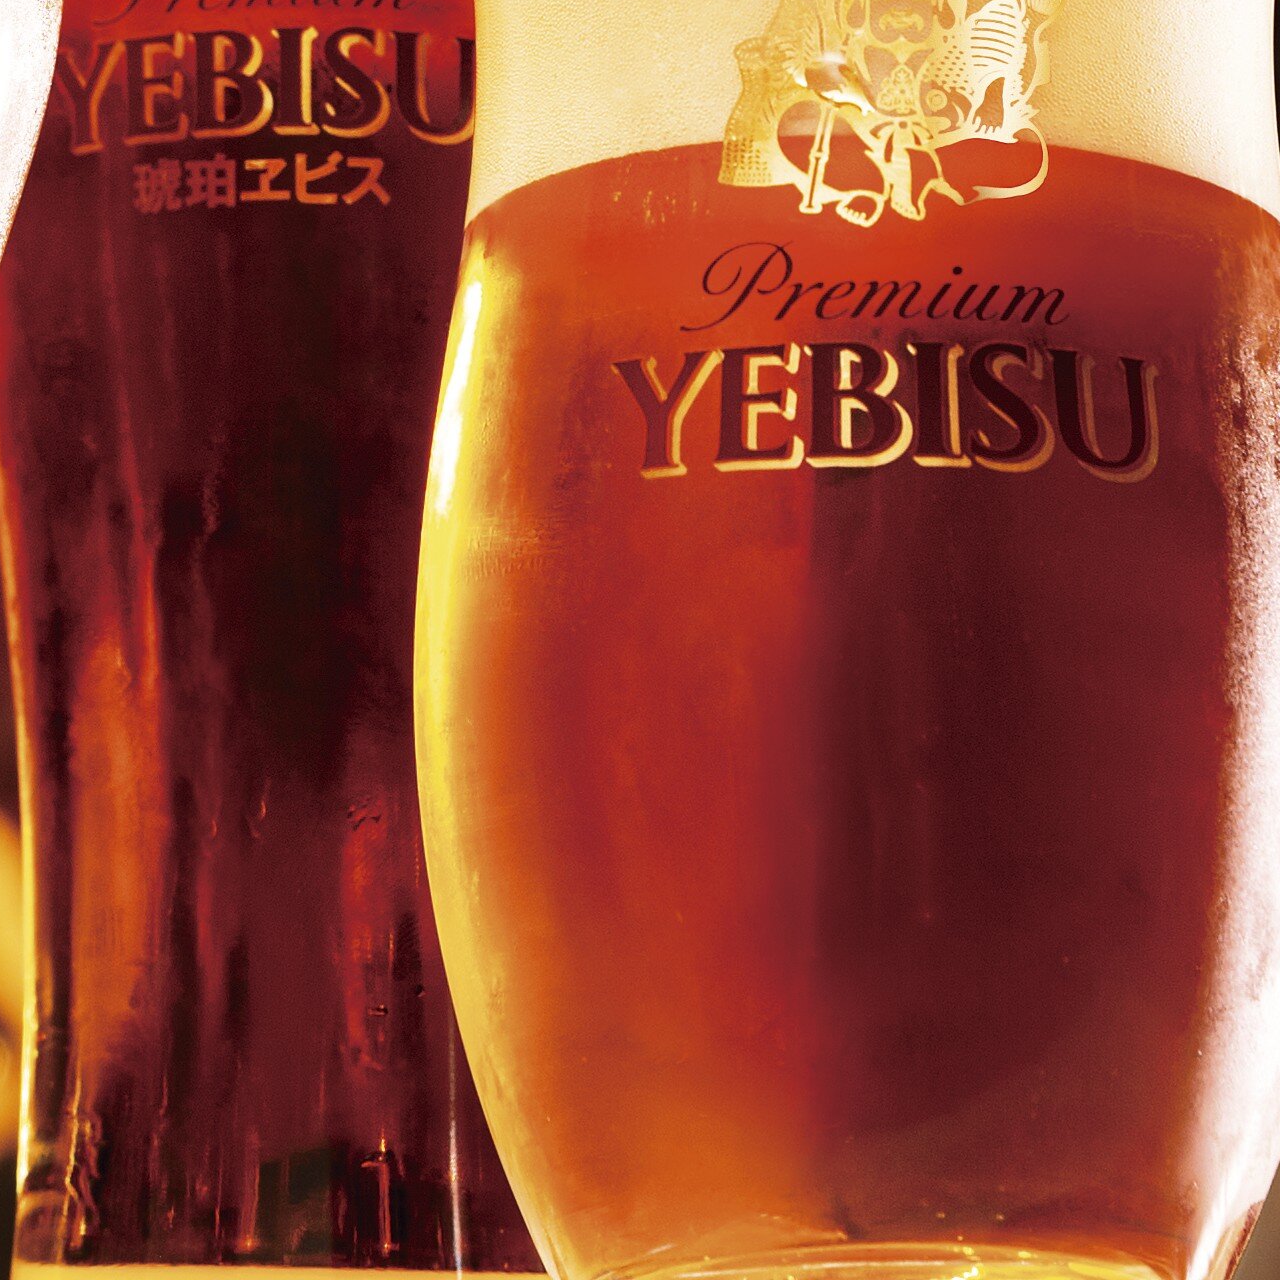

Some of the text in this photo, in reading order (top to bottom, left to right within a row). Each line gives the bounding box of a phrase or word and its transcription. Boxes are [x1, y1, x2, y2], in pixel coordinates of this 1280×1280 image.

[58, 25, 476, 156] YEBISU
[680, 240, 1070, 333] Premium
[611, 341, 1160, 484] YEBISU
